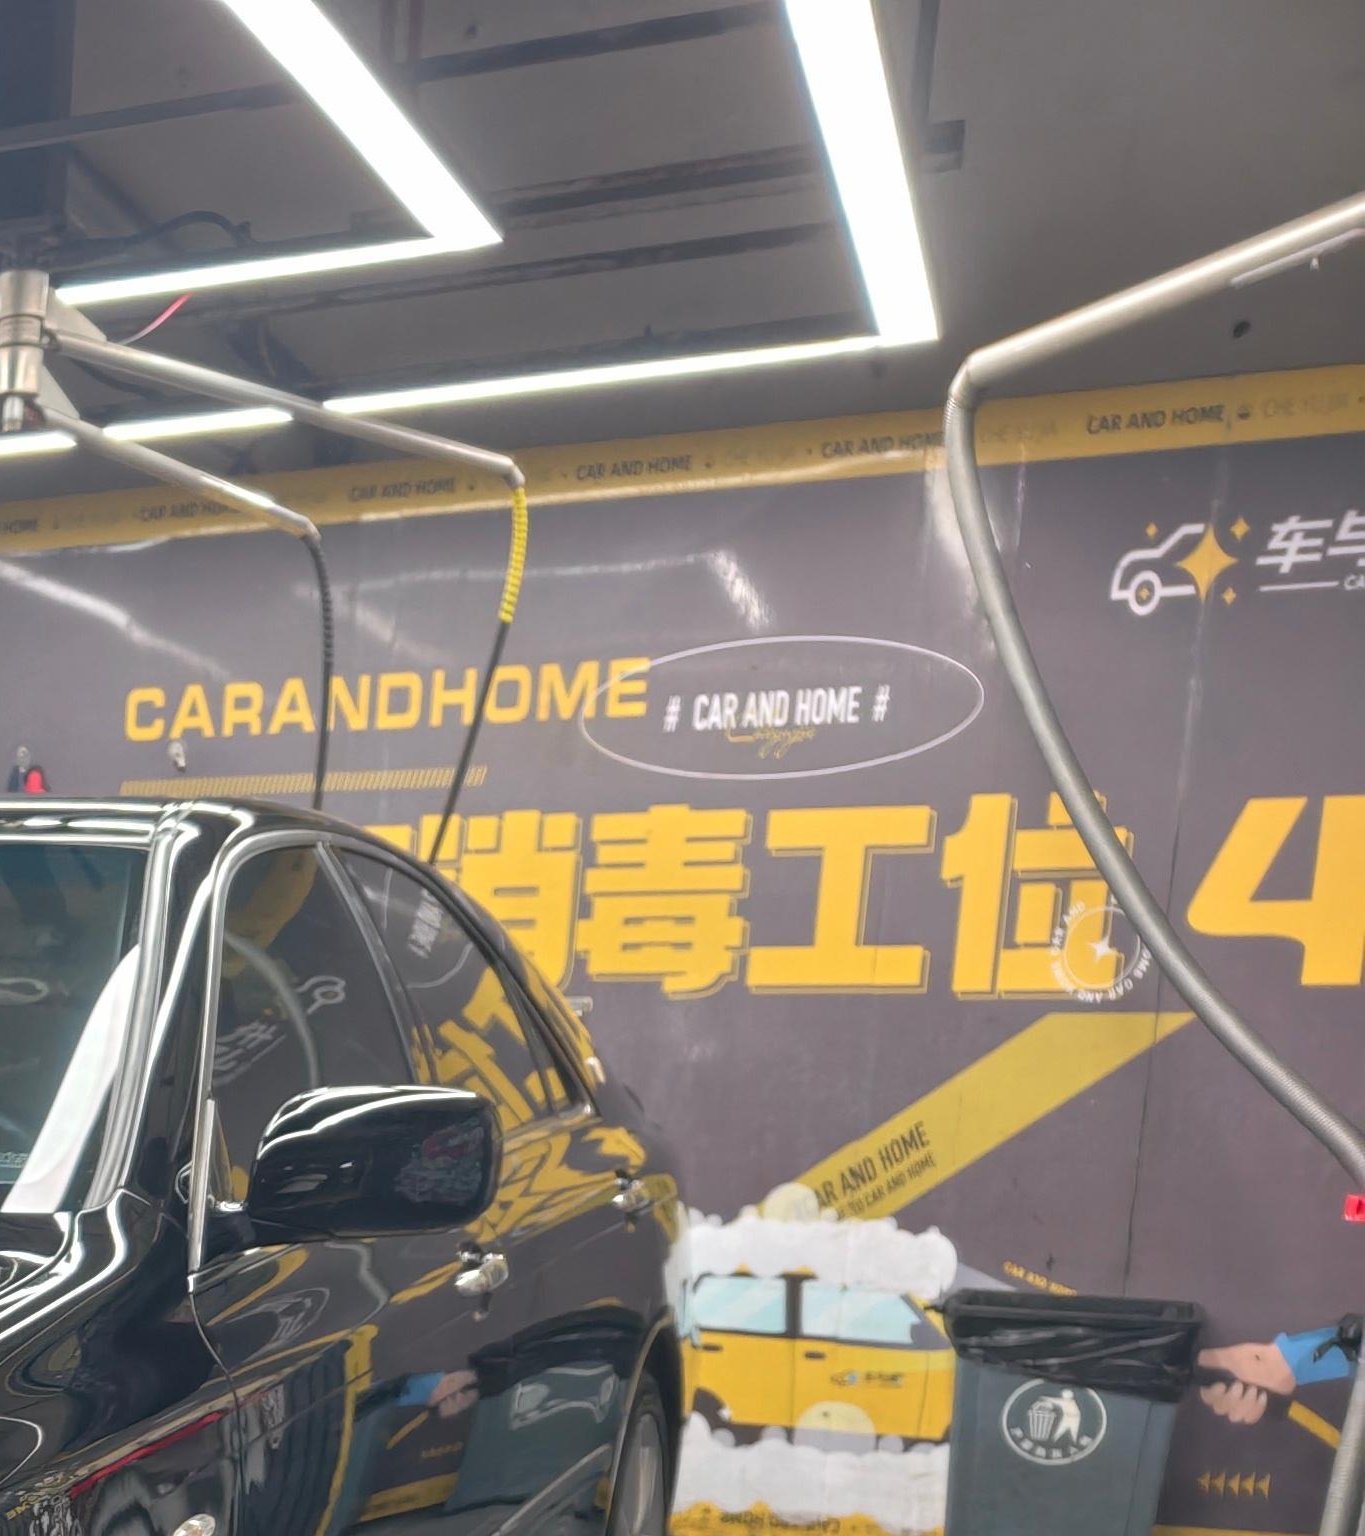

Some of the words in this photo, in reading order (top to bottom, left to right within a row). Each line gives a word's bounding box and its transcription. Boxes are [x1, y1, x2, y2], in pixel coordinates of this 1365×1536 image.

[1086, 414, 1121, 434] CAR
[1126, 410, 1166, 429] AND
[1171, 404, 1225, 424] HOME
[822, 442, 853, 458] CAR
[858, 437, 893, 452] AND
[576, 465, 606, 480] CAR
[611, 461, 644, 477] AND
[647, 456, 692, 472] HOME
[124, 657, 651, 742] CARANDHOME
[692, 692, 738, 731] CAR
[740, 690, 789, 728] AND
[794, 686, 862, 726] HOME
[366, 793, 1134, 1000] 消毒工位
[814, 1180, 836, 1208] AR
[840, 1156, 877, 1197] AND
[878, 1120, 930, 1171] HOME
[907, 1152, 936, 1180] HOME
